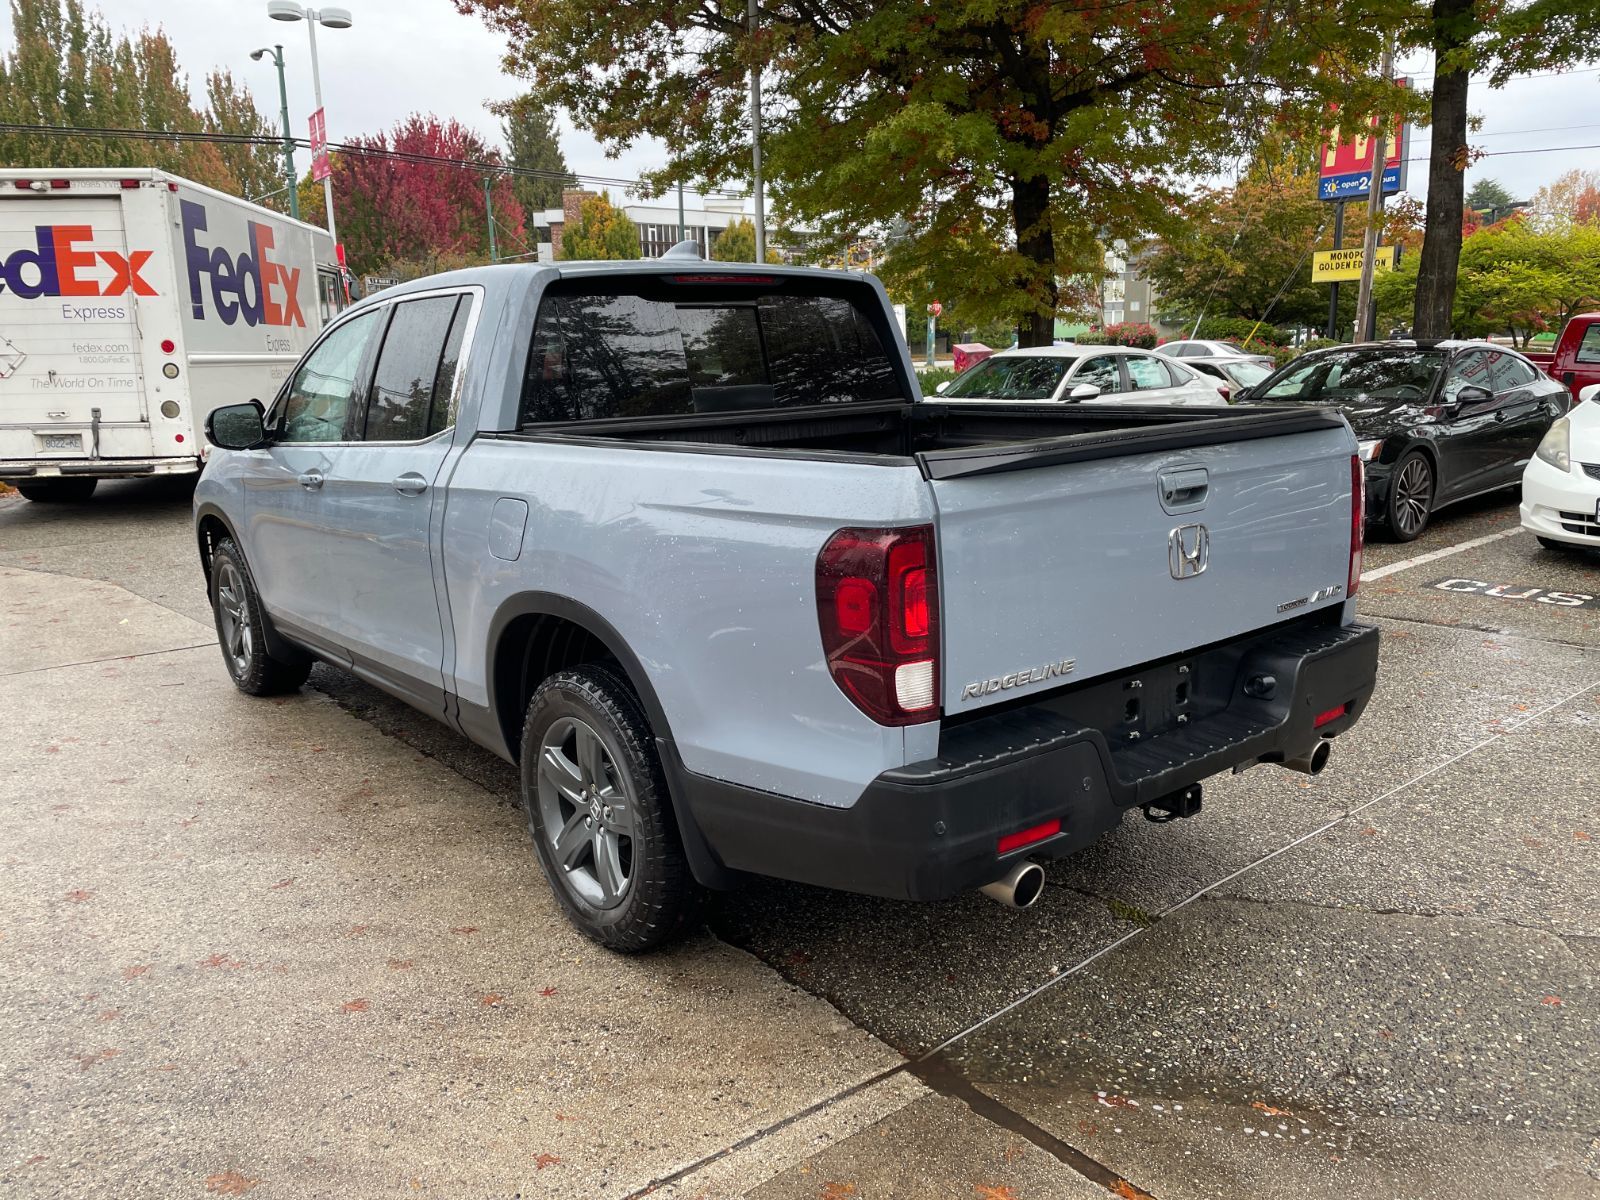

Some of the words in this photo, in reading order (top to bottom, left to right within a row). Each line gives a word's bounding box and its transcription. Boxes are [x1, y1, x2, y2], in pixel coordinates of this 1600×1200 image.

[1341, 181, 1359, 189] open
[1359, 177, 1372, 190] 2
[0, 225, 160, 299] dEx
[179, 199, 306, 327] FedEx
[1330, 251, 1365, 261] MONOPO
[1319, 261, 1351, 271] GOLDEN
[1353, 259, 1386, 269] EDON
[62, 304, 125, 322] Express
[72, 342, 129, 353] fedex.com
[266, 334, 291, 353] Express
[31, 378, 50, 390] The
[52, 377, 85, 389] World
[88, 378, 104, 388] On
[107, 377, 134, 388] Time
[961, 658, 1077, 702] RIDGELINE
